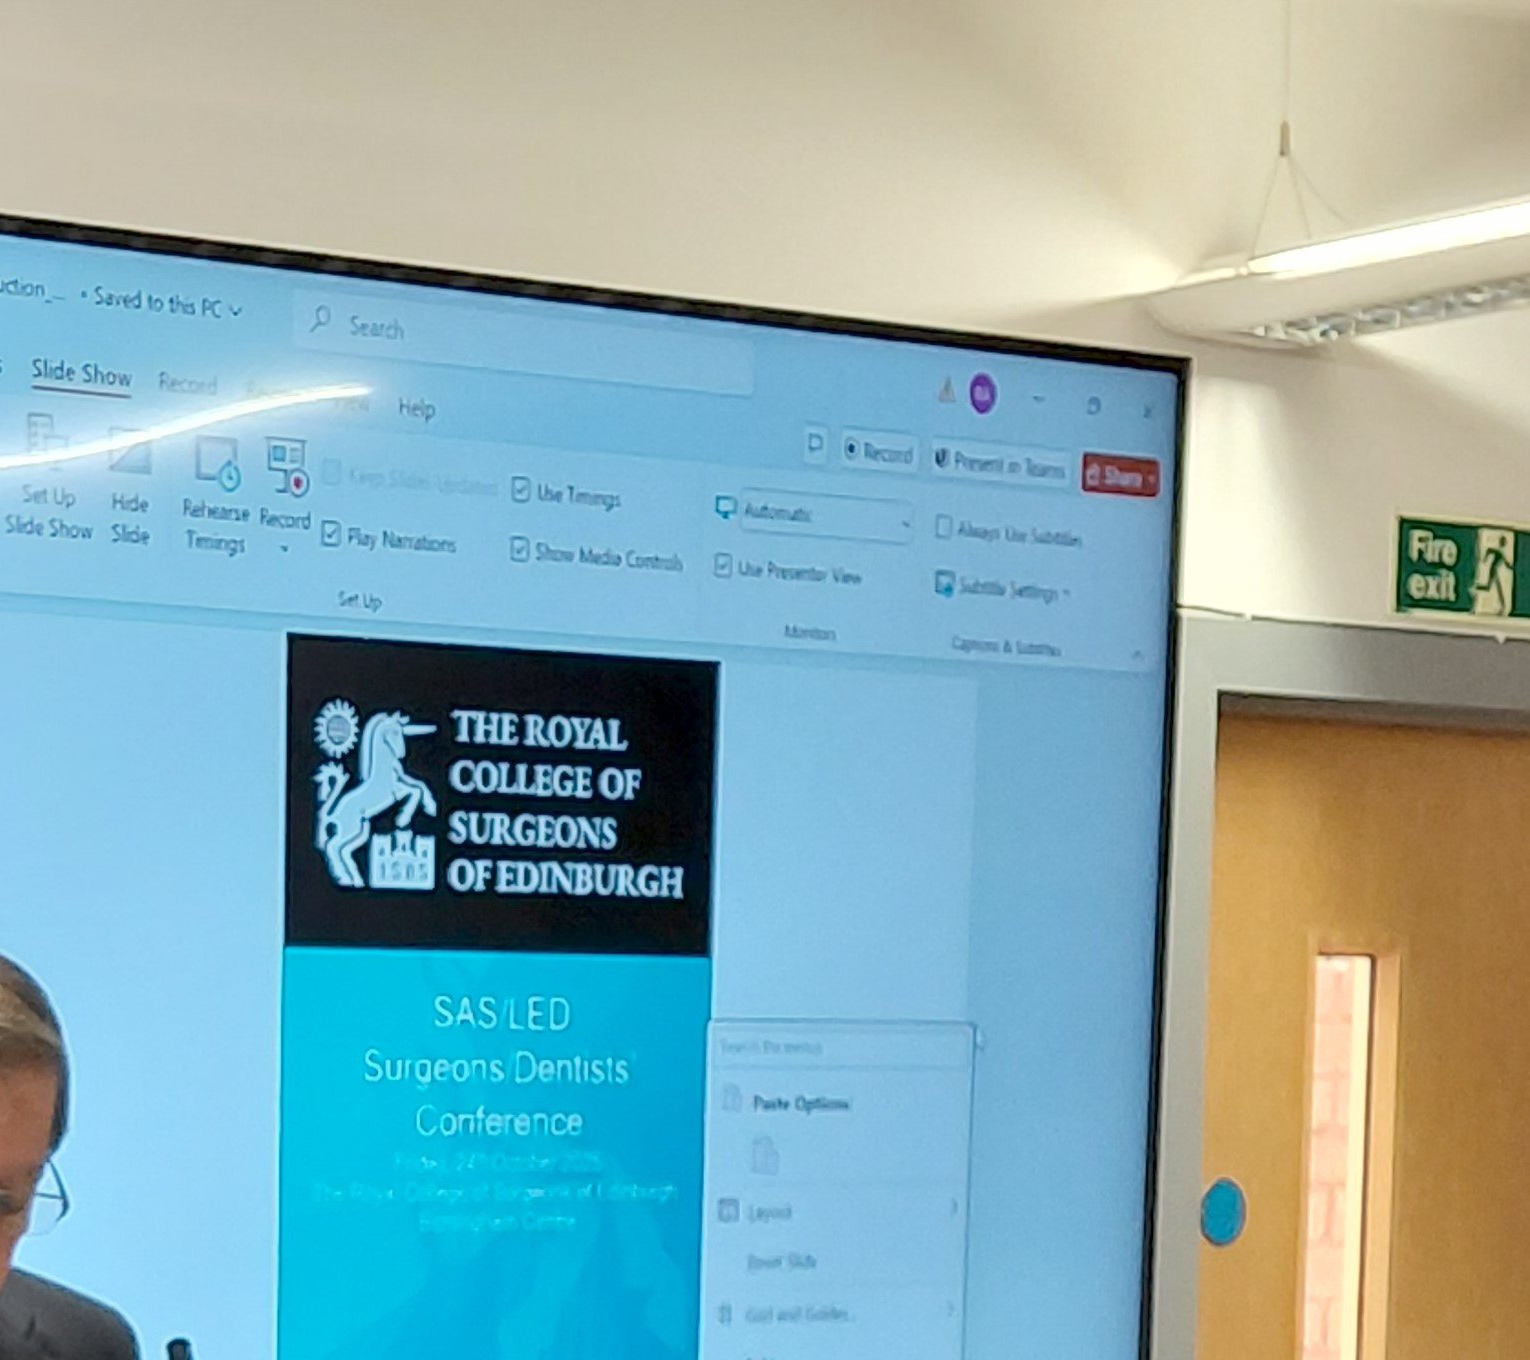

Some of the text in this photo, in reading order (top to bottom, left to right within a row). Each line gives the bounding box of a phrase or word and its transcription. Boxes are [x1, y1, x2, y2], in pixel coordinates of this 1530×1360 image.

[95, 287, 141, 310] Saved
[148, 292, 164, 312] to
[169, 295, 196, 316] this
[202, 298, 222, 318] PC
[350, 315, 404, 341] Search
[32, 359, 75, 383] Slide
[82, 363, 132, 387] Show
[399, 398, 436, 423] Help
[23, 485, 76, 510] Set Up
[112, 494, 149, 515] Hide
[183, 499, 250, 524] Rehearse
[6, 516, 94, 542] Slide Show
[260, 508, 311, 531] Record
[112, 525, 150, 546] Slide
[186, 530, 246, 557] Timings
[1408, 528, 1458, 567] Fire
[1407, 569, 1457, 602] exit
[448, 709, 629, 752] THE ROYAL
[448, 759, 642, 801] COLLEGE OF
[448, 810, 618, 851] SURGEONS
[447, 858, 685, 899] OF EDINBURGH
[416, 1103, 584, 1137] Conference
